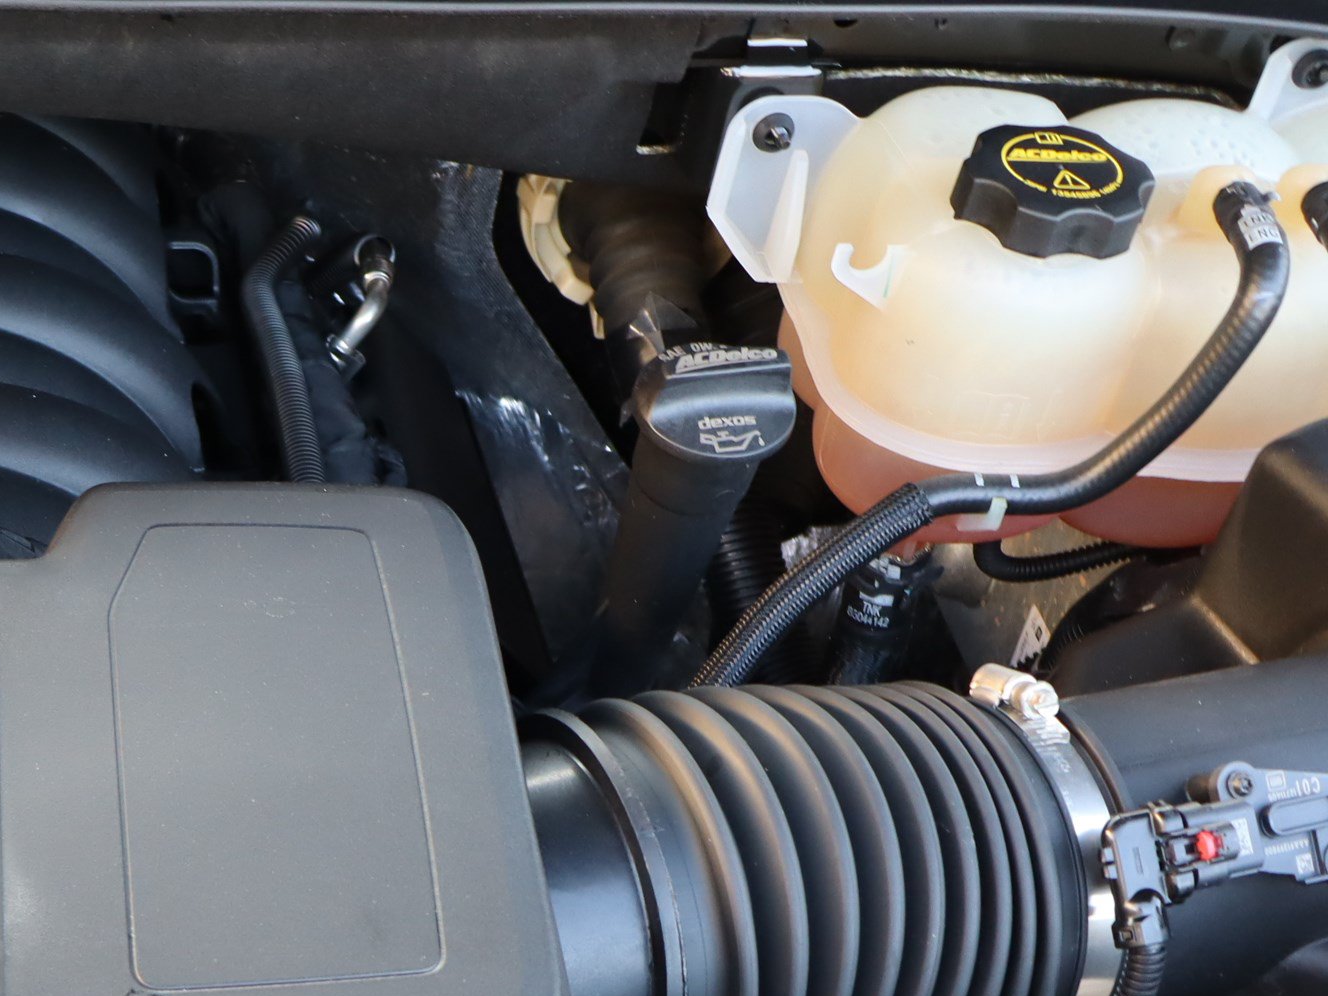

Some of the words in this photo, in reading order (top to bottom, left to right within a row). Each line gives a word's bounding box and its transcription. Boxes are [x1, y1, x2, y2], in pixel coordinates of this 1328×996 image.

[1007, 147, 1108, 163] ACDelco
[675, 347, 778, 371] ACDelco
[697, 415, 757, 430] dexos
[862, 601, 882, 618] TNK
